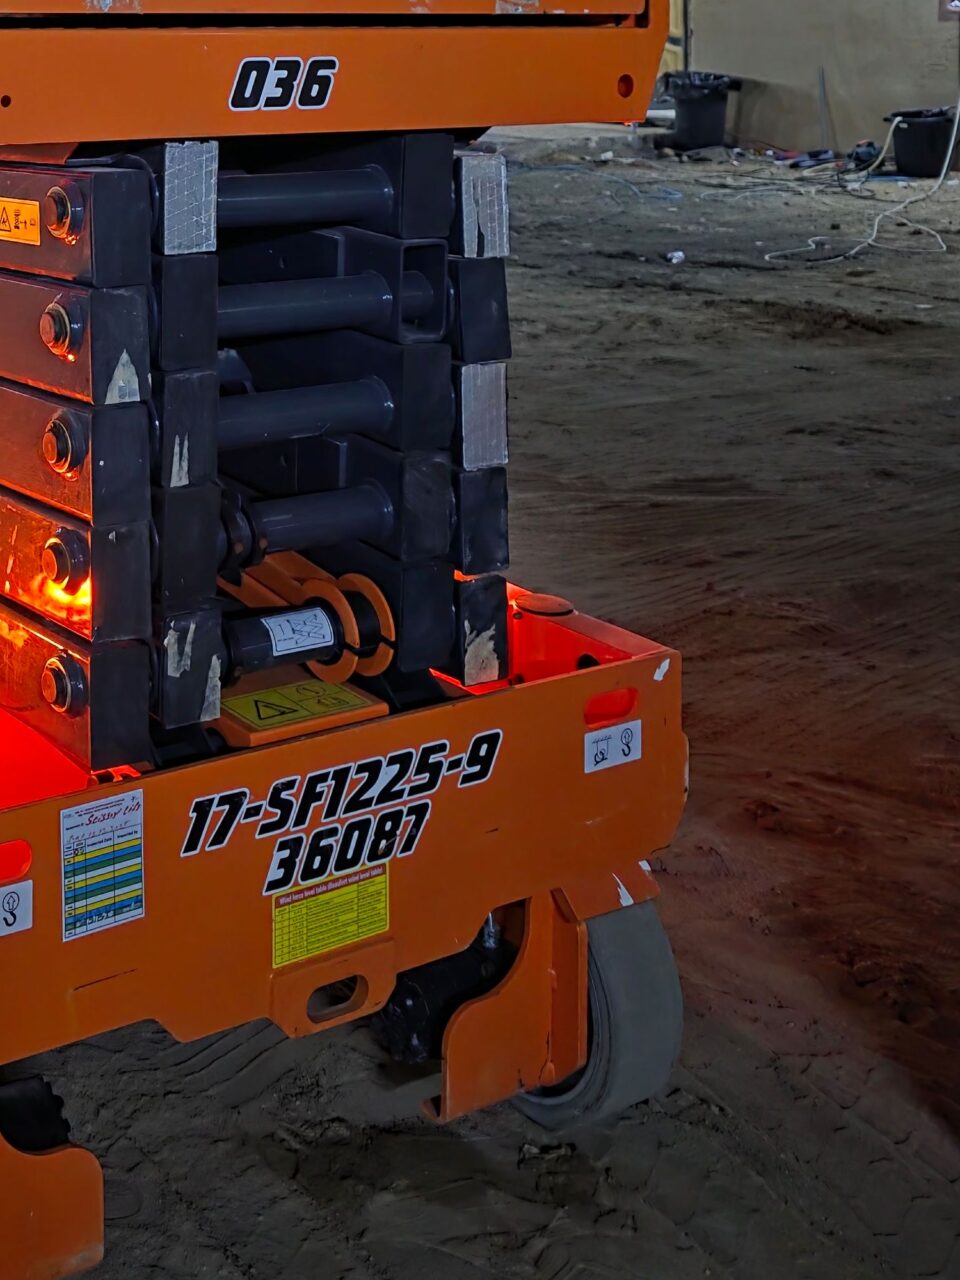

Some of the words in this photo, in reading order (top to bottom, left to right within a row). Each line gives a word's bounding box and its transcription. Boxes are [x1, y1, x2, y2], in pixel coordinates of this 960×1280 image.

[228, 56, 339, 111] 036
[180, 728, 503, 857] 17-SF1225-9
[262, 799, 431, 896] 36087
